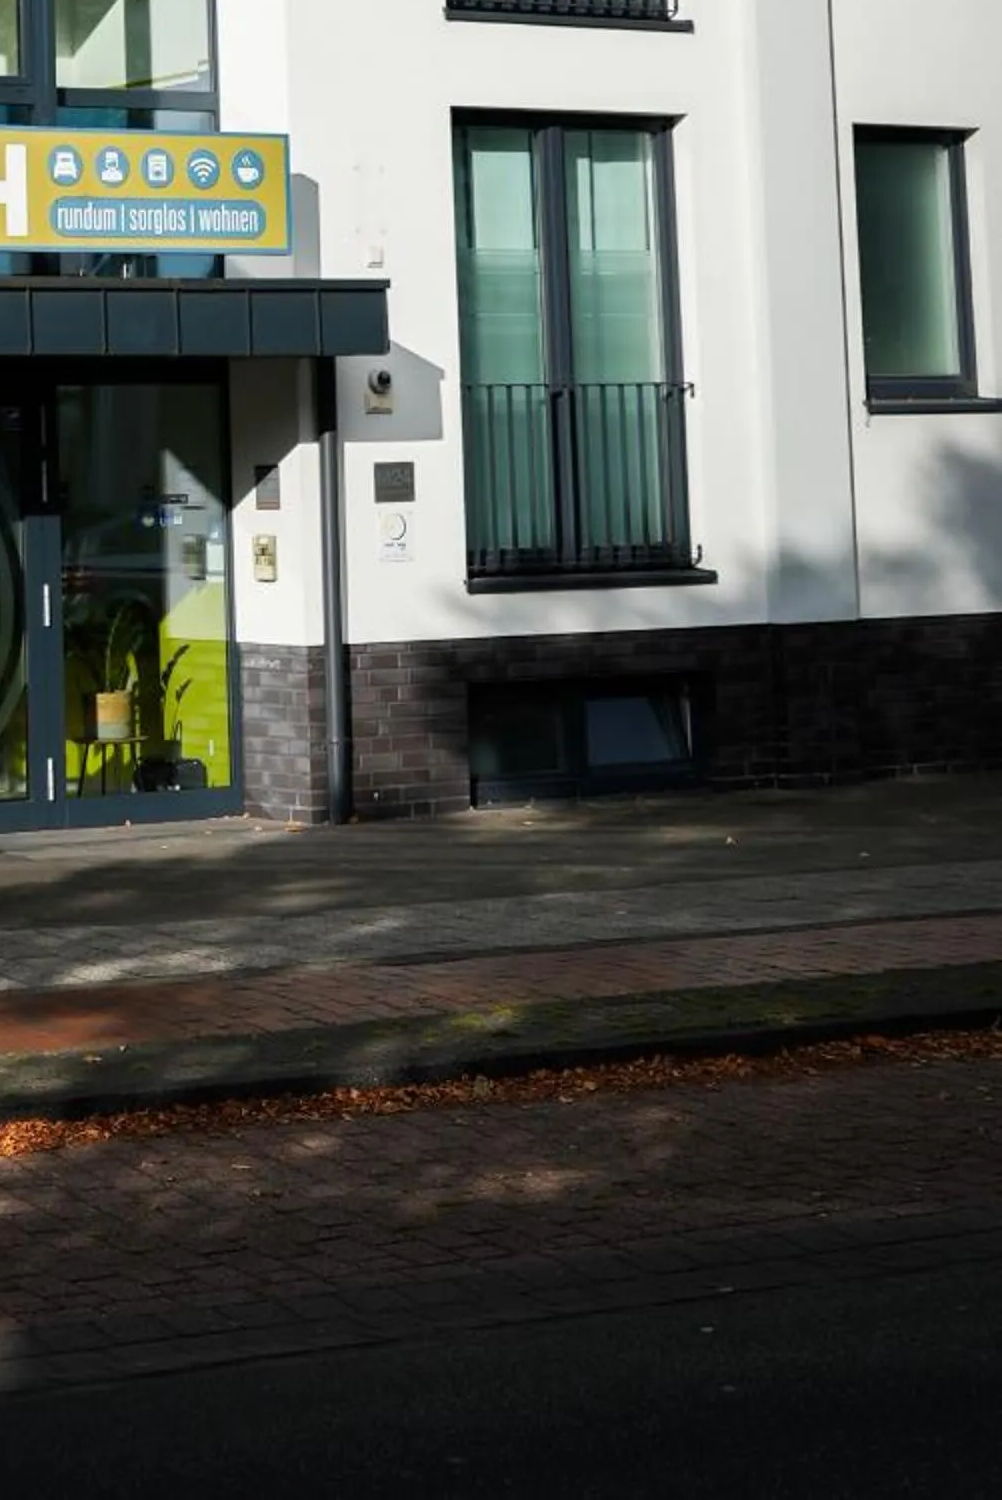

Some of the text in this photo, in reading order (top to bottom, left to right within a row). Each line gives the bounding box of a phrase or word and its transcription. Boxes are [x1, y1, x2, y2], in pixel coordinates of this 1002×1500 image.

[57, 202, 260, 234] rundum sorglos wohnen
